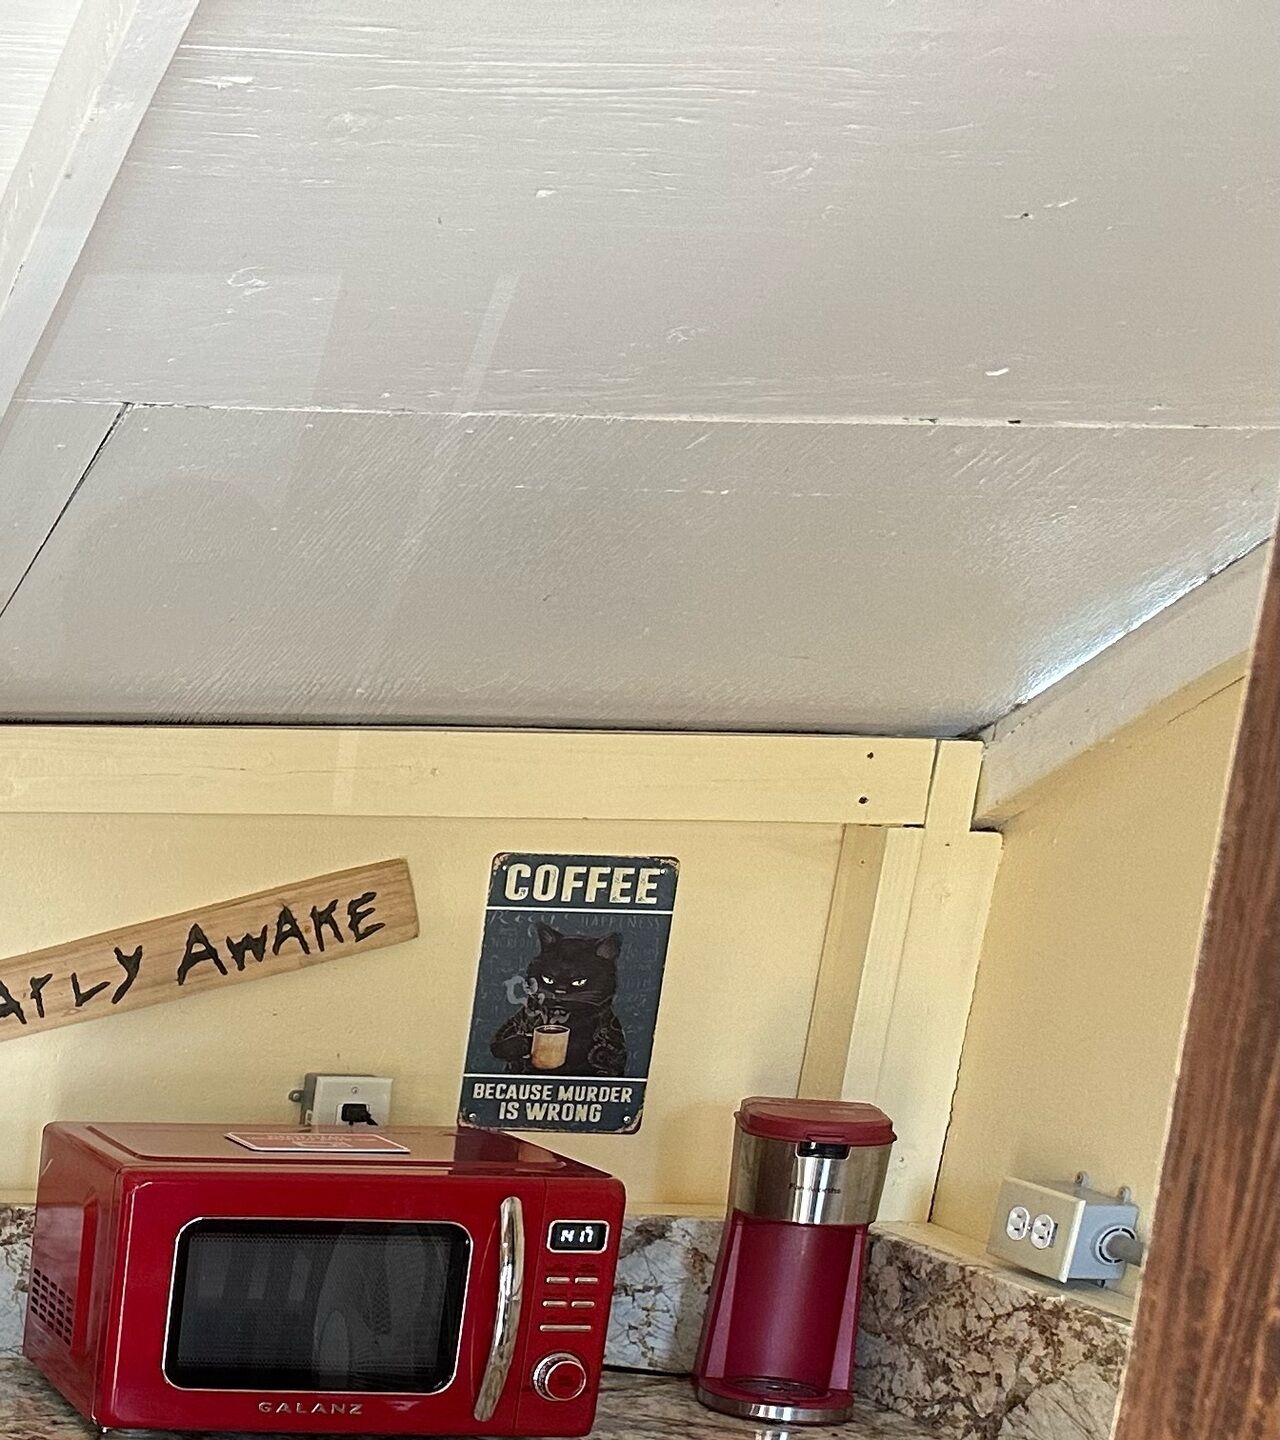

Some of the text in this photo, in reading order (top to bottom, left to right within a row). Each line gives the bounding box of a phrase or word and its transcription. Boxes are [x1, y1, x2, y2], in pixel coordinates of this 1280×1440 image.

[504, 863, 662, 905] COFFEE
[472, 1083, 633, 1104] BECAUSE MURDER
[498, 1101, 603, 1123] IS WRONG
[258, 1402, 364, 1415] GALANZ
